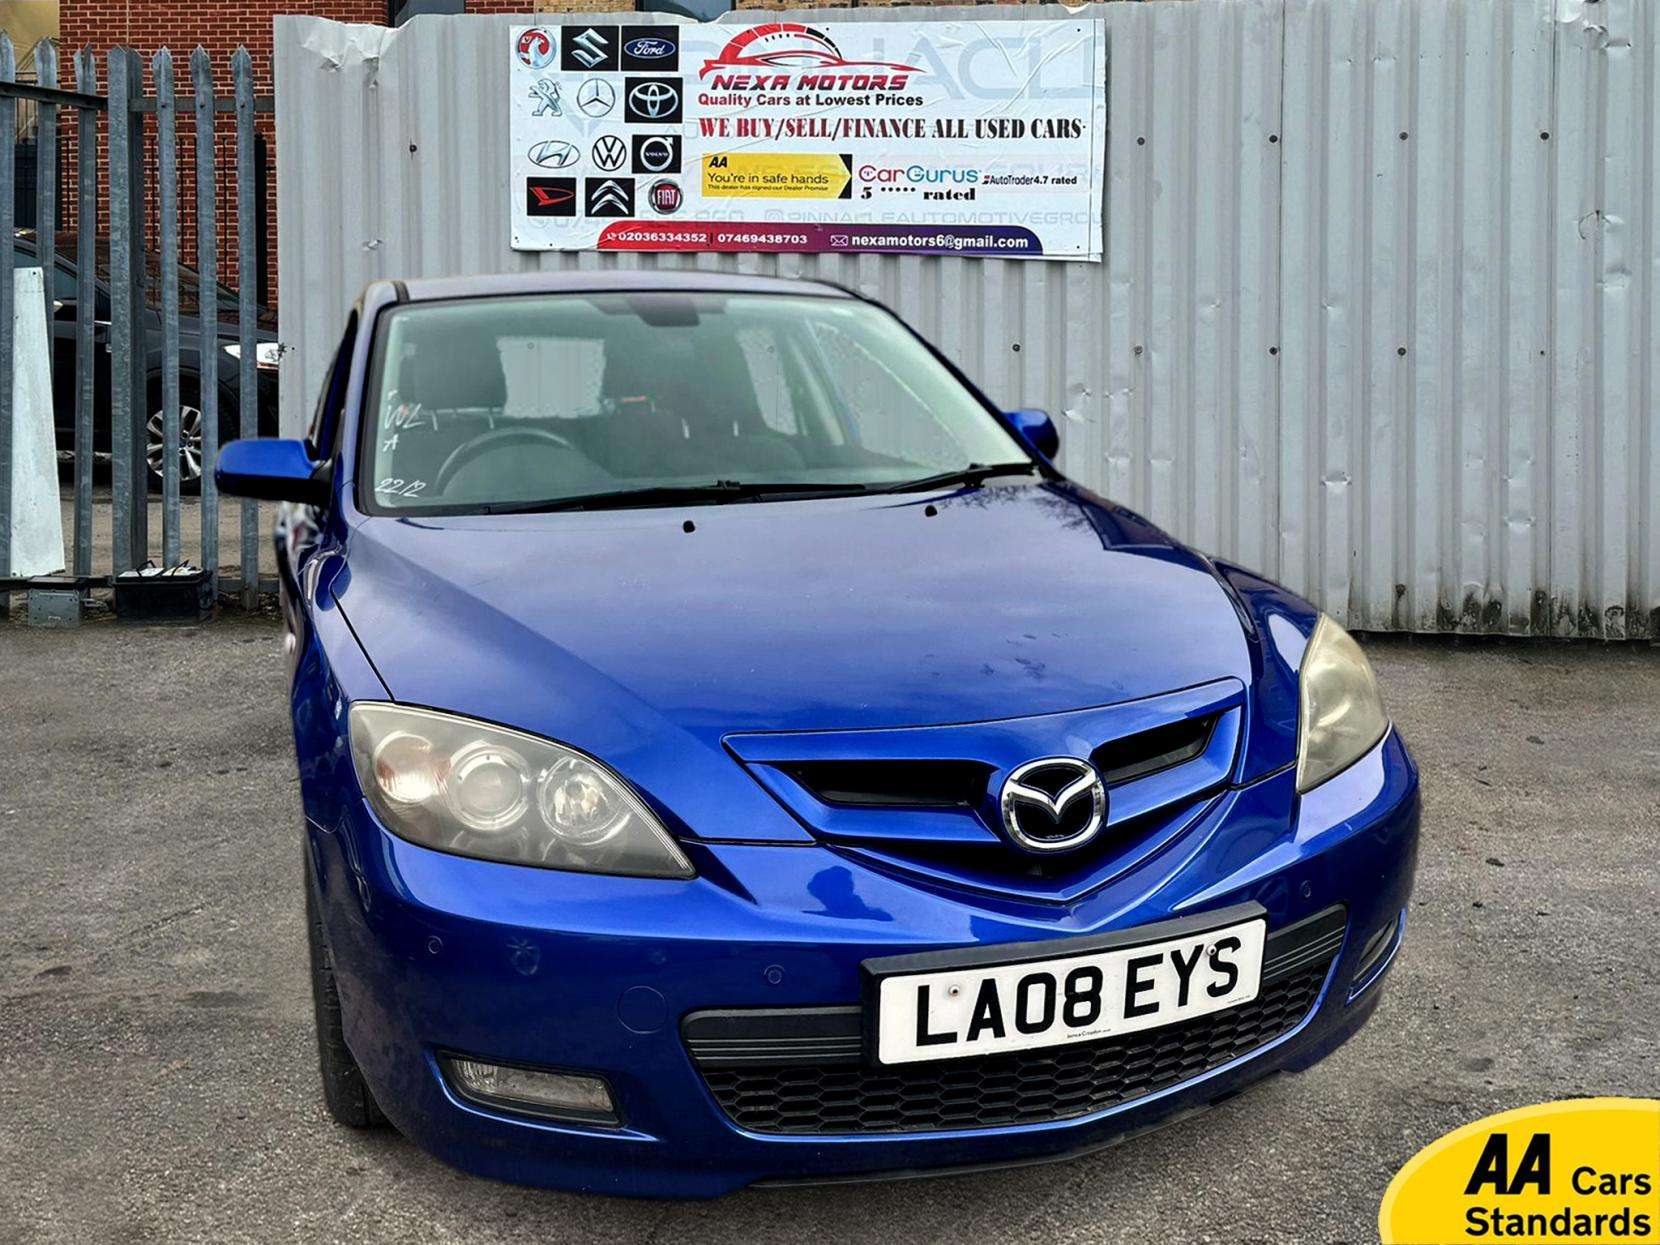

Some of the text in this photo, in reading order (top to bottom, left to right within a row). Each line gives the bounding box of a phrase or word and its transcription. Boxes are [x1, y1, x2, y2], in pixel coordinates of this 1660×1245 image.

[634, 41, 665, 55] Ford
[711, 75, 909, 90] NEXA MOTORS
[698, 93, 923, 107] Quality Cars at Lowest Prices
[698, 118, 730, 138] WE
[931, 118, 969, 139] ALL
[975, 118, 1026, 139] USED
[709, 156, 728, 168] AA
[707, 172, 829, 184] You're in safe hands
[858, 164, 979, 184] CarGurus
[1051, 175, 1077, 184] rated
[656, 190, 676, 205] FIAT
[861, 186, 976, 201] 5 rated
[618, 232, 808, 245] 02036334352 07469438703
[852, 234, 1029, 249] nexamotors6@gmail.com
[916, 936, 1242, 1047] LA08 EYS
